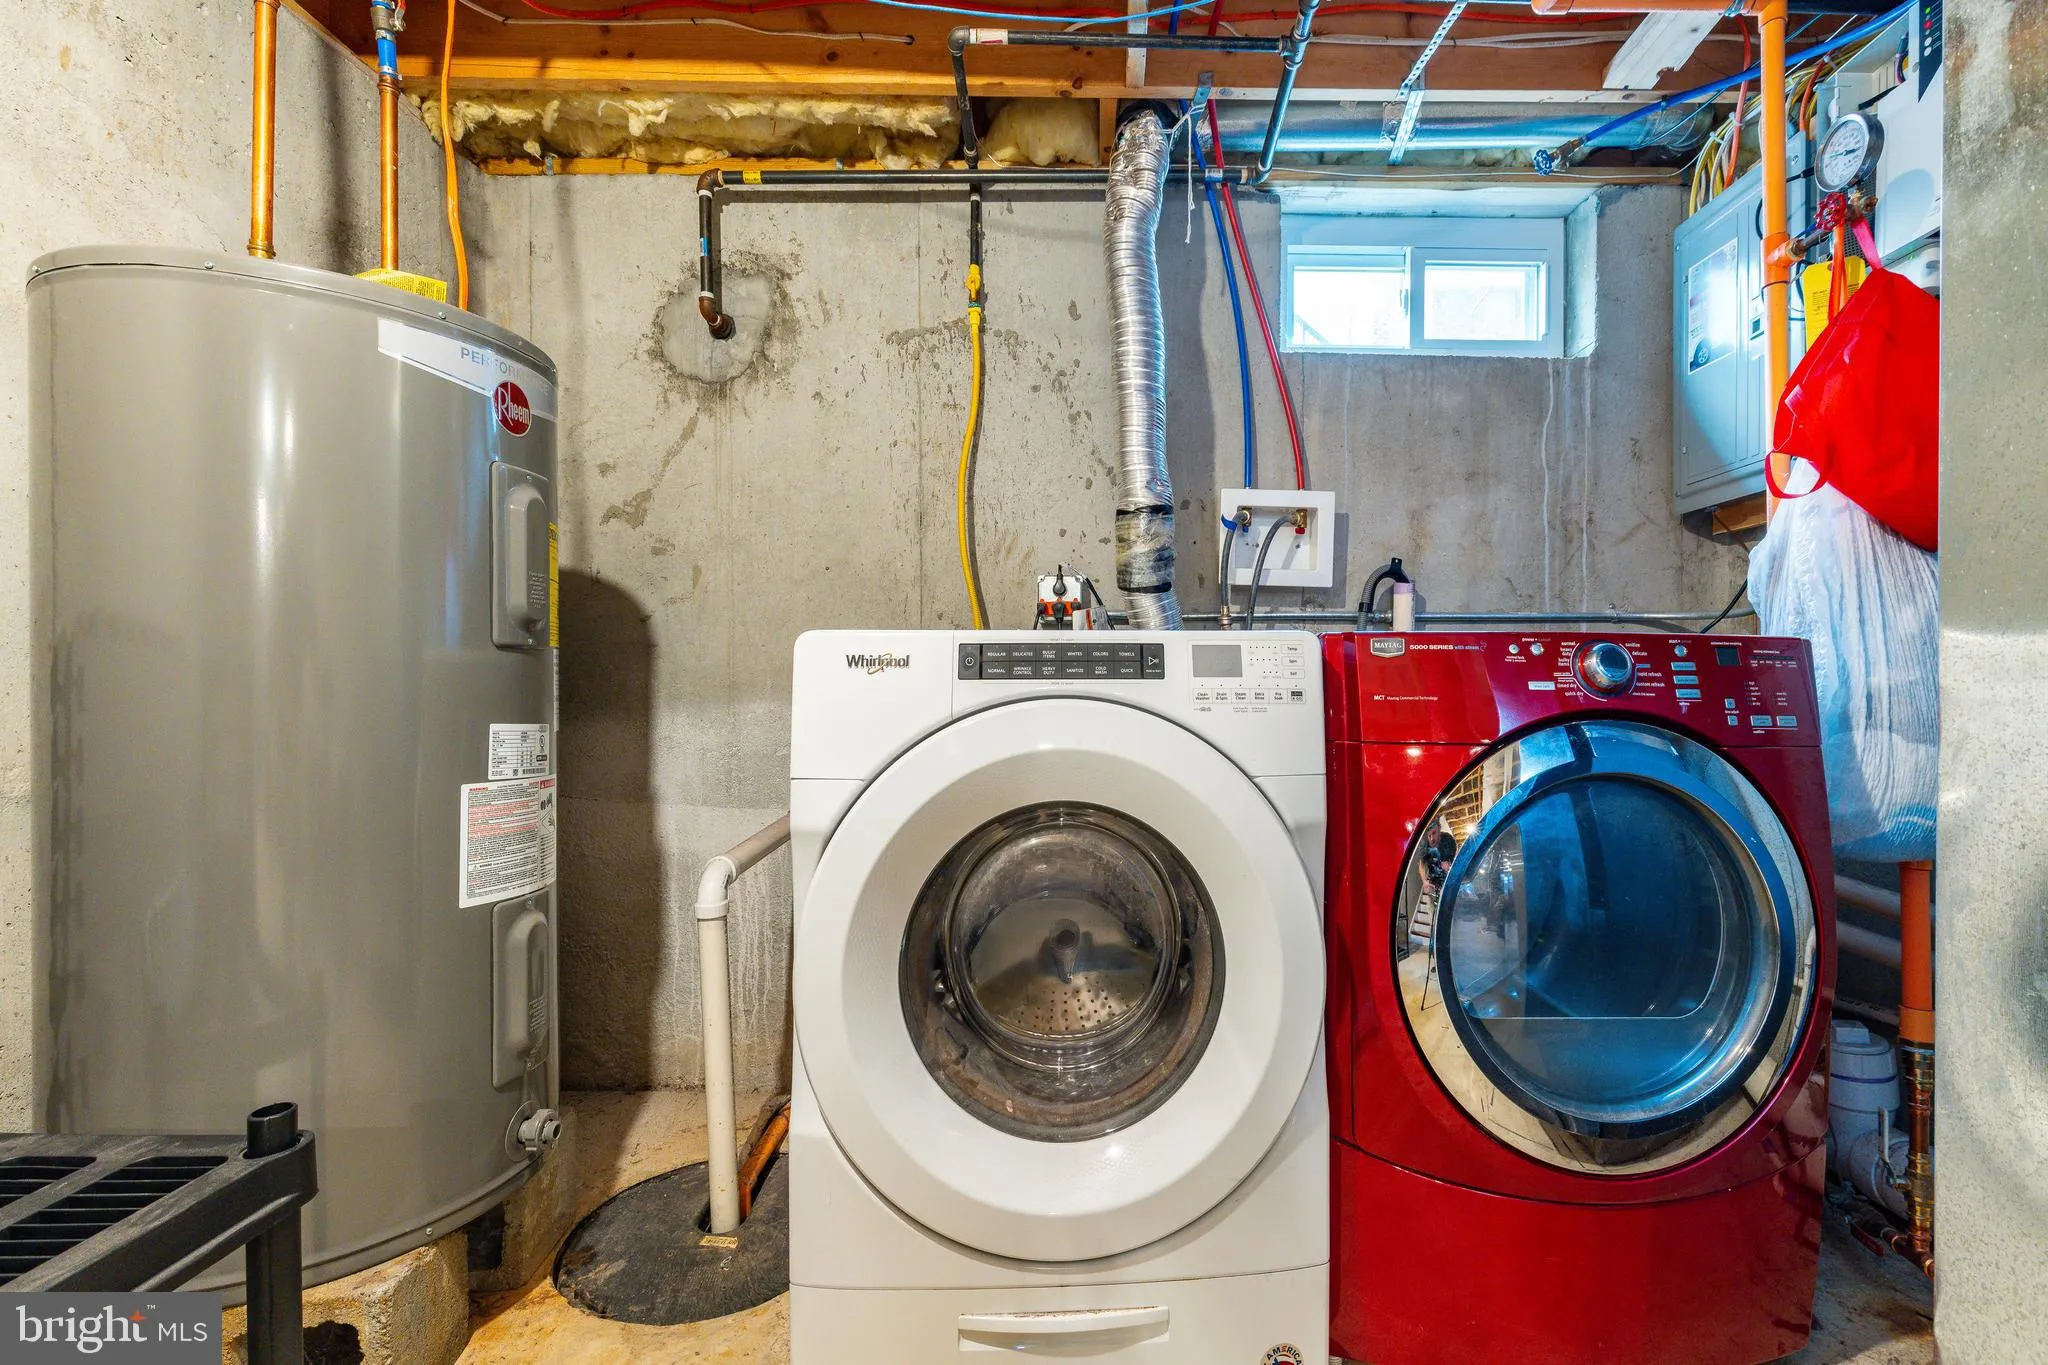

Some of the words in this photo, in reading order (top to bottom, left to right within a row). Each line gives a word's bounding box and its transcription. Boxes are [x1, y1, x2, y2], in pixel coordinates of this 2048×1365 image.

[497, 382, 530, 426] Rheem
[1374, 641, 1402, 649] MAYTAG
[845, 653, 910, 674] Whirlpool
